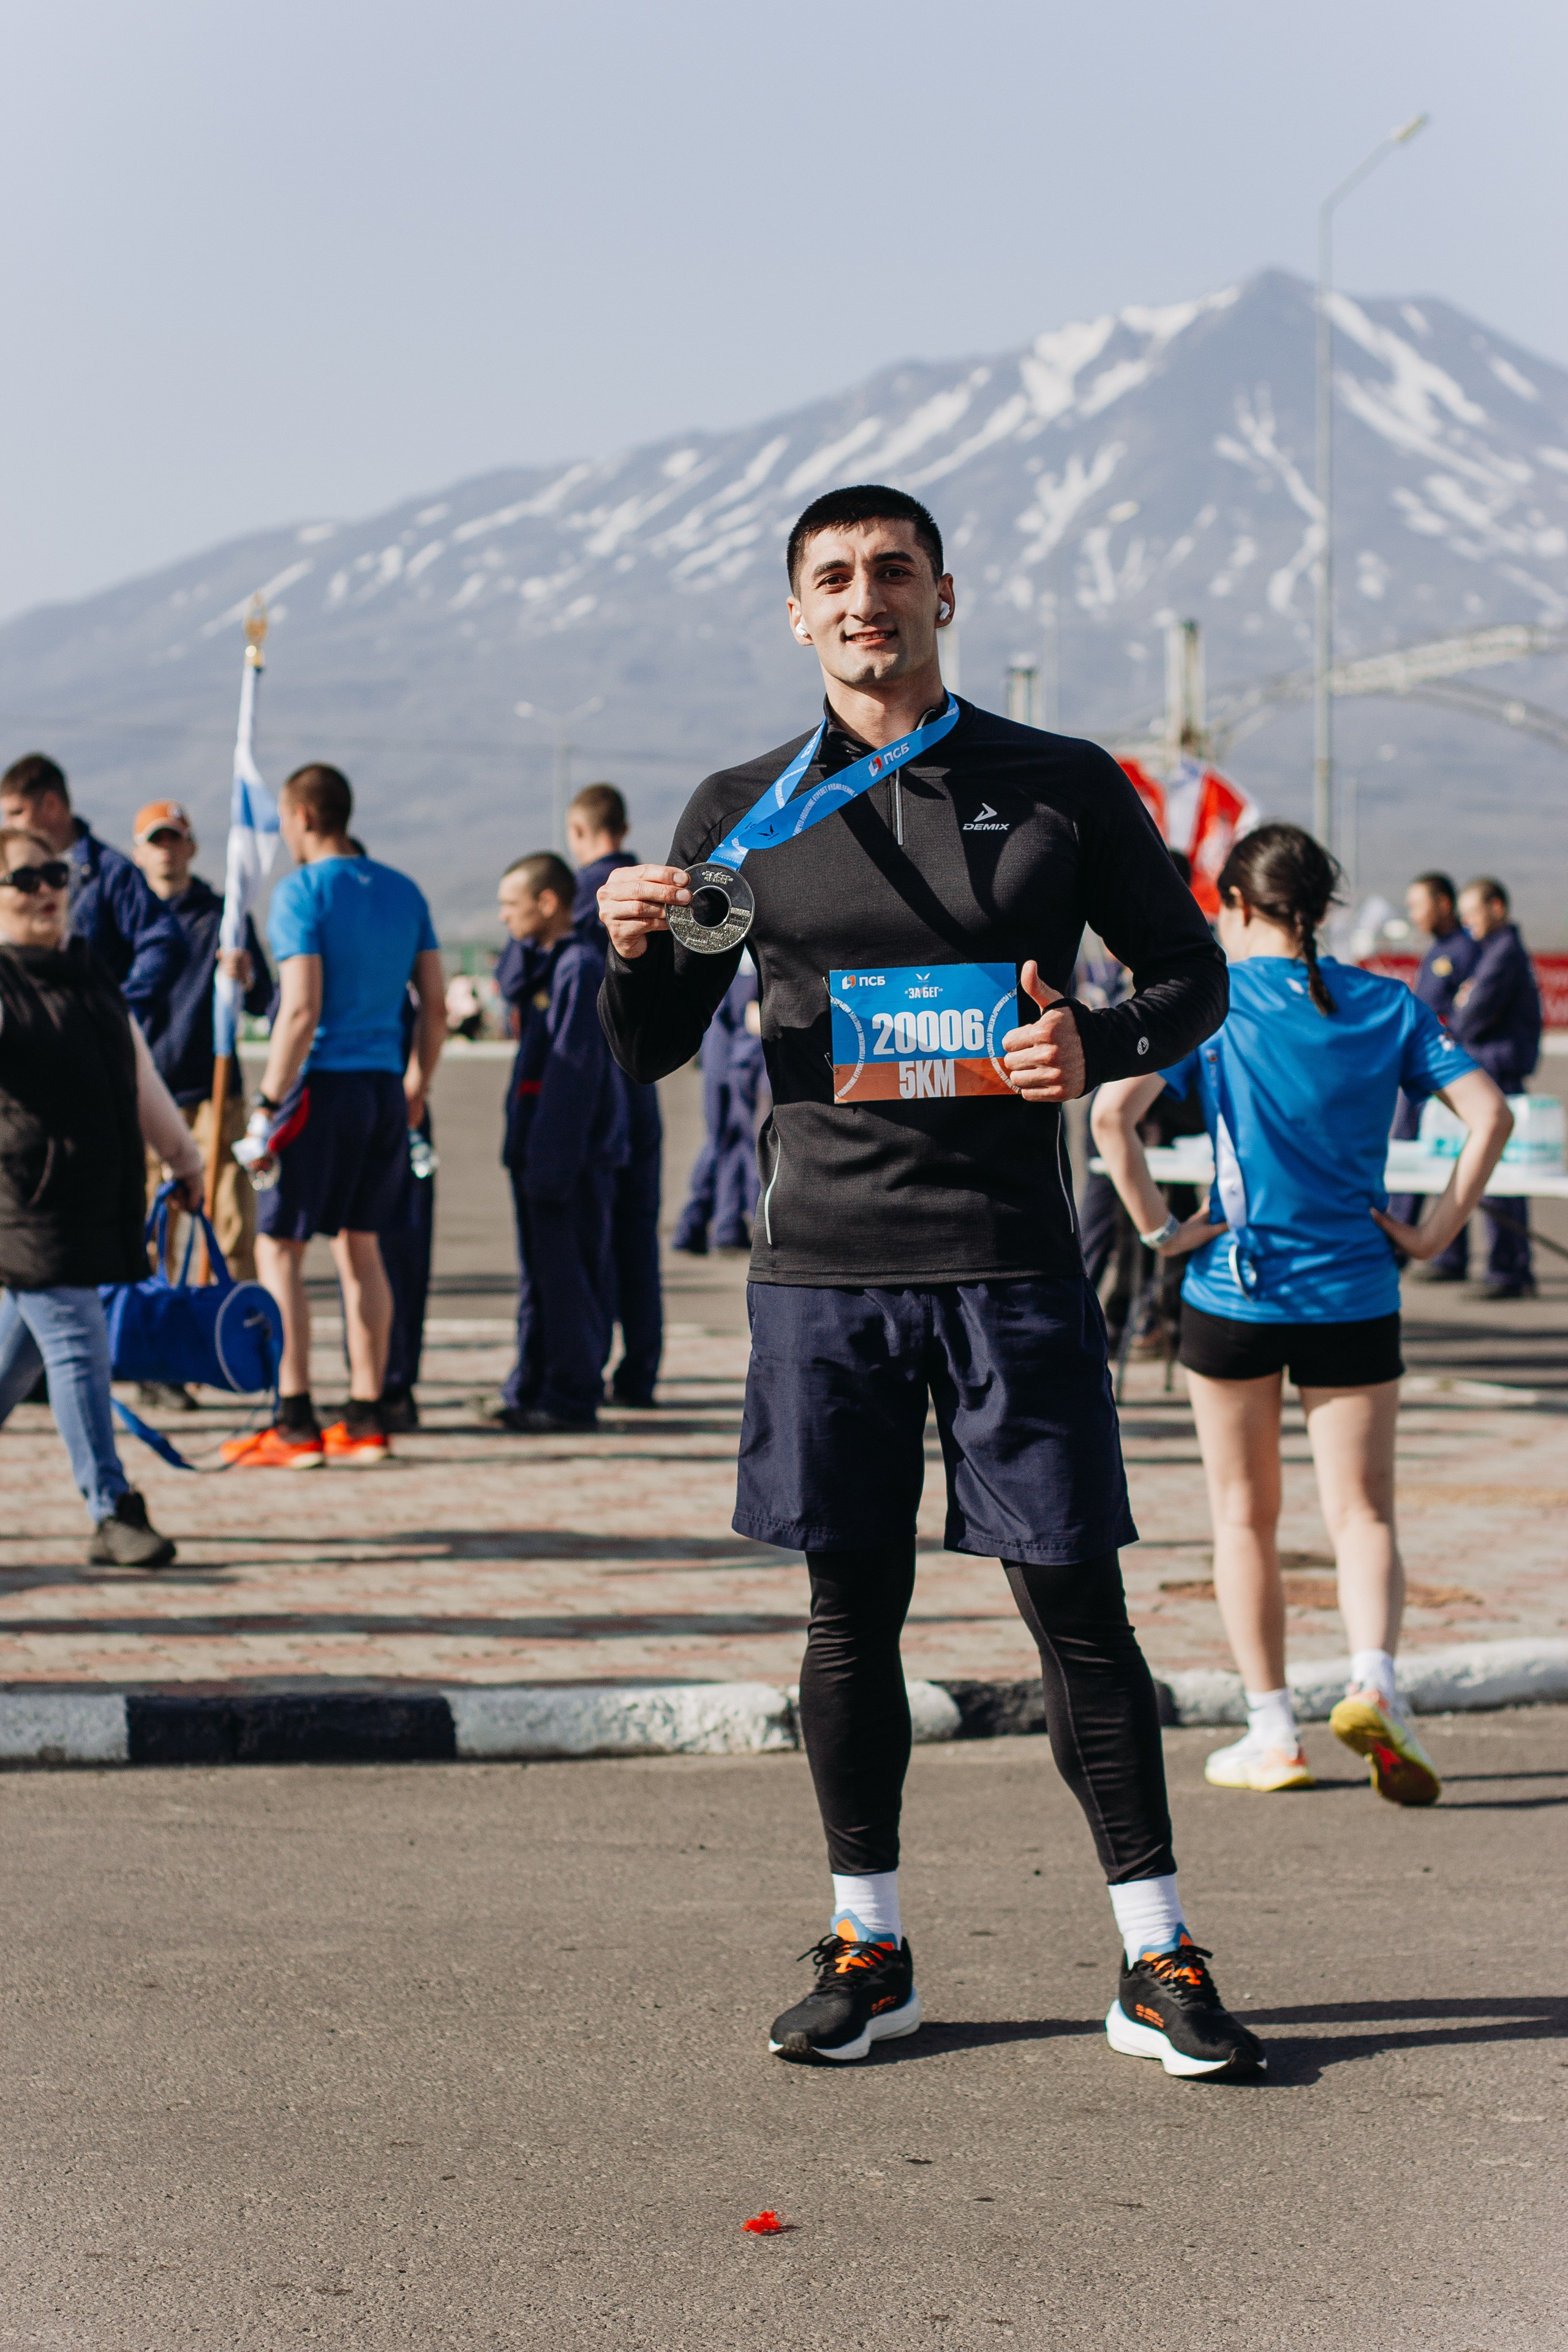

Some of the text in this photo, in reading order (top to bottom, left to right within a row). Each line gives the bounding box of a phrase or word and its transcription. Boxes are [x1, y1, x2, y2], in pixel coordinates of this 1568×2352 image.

[883, 743, 910, 765] ПСБ
[859, 976, 886, 987] ПСБ
[872, 1008, 985, 1055] 20006
